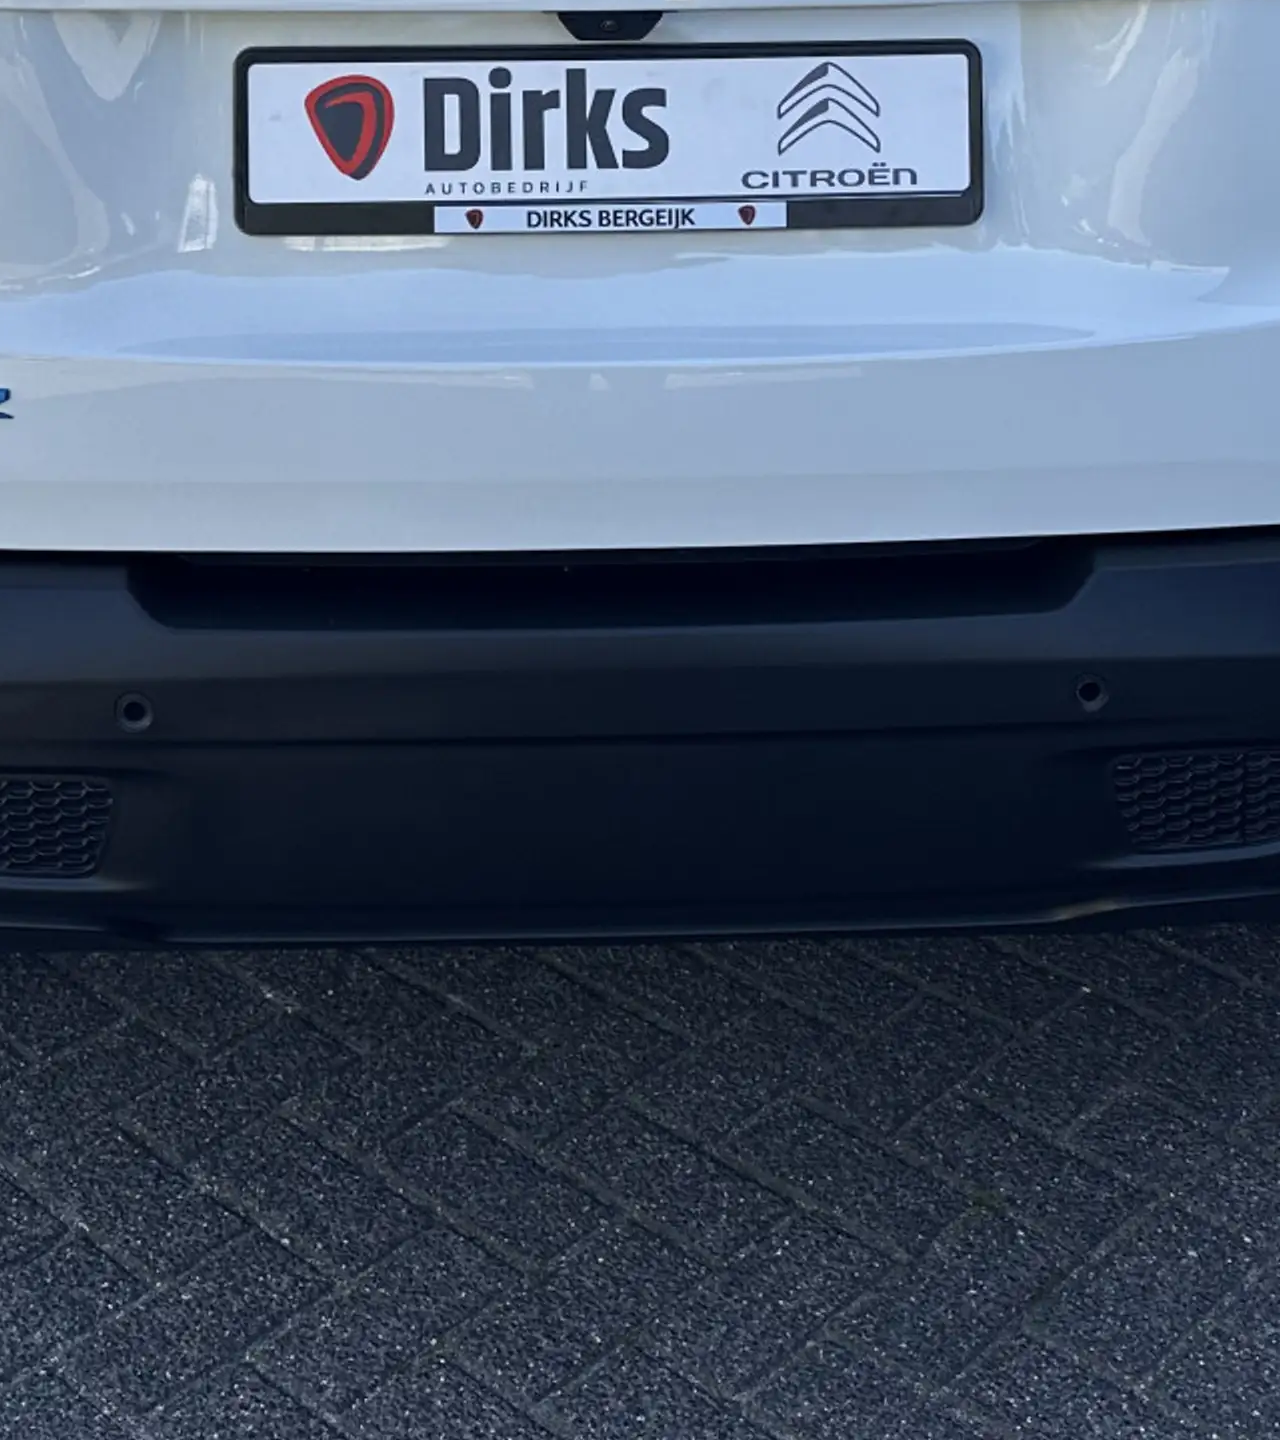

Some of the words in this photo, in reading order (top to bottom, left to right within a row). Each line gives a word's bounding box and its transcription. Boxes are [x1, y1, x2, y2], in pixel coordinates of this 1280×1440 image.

[423, 67, 670, 172] Dirks
[424, 180, 588, 195] AUTOBEDRIJF
[741, 162, 918, 190] CITROËN
[526, 209, 592, 229] DIRKS
[598, 208, 696, 229] BERGEIJK
